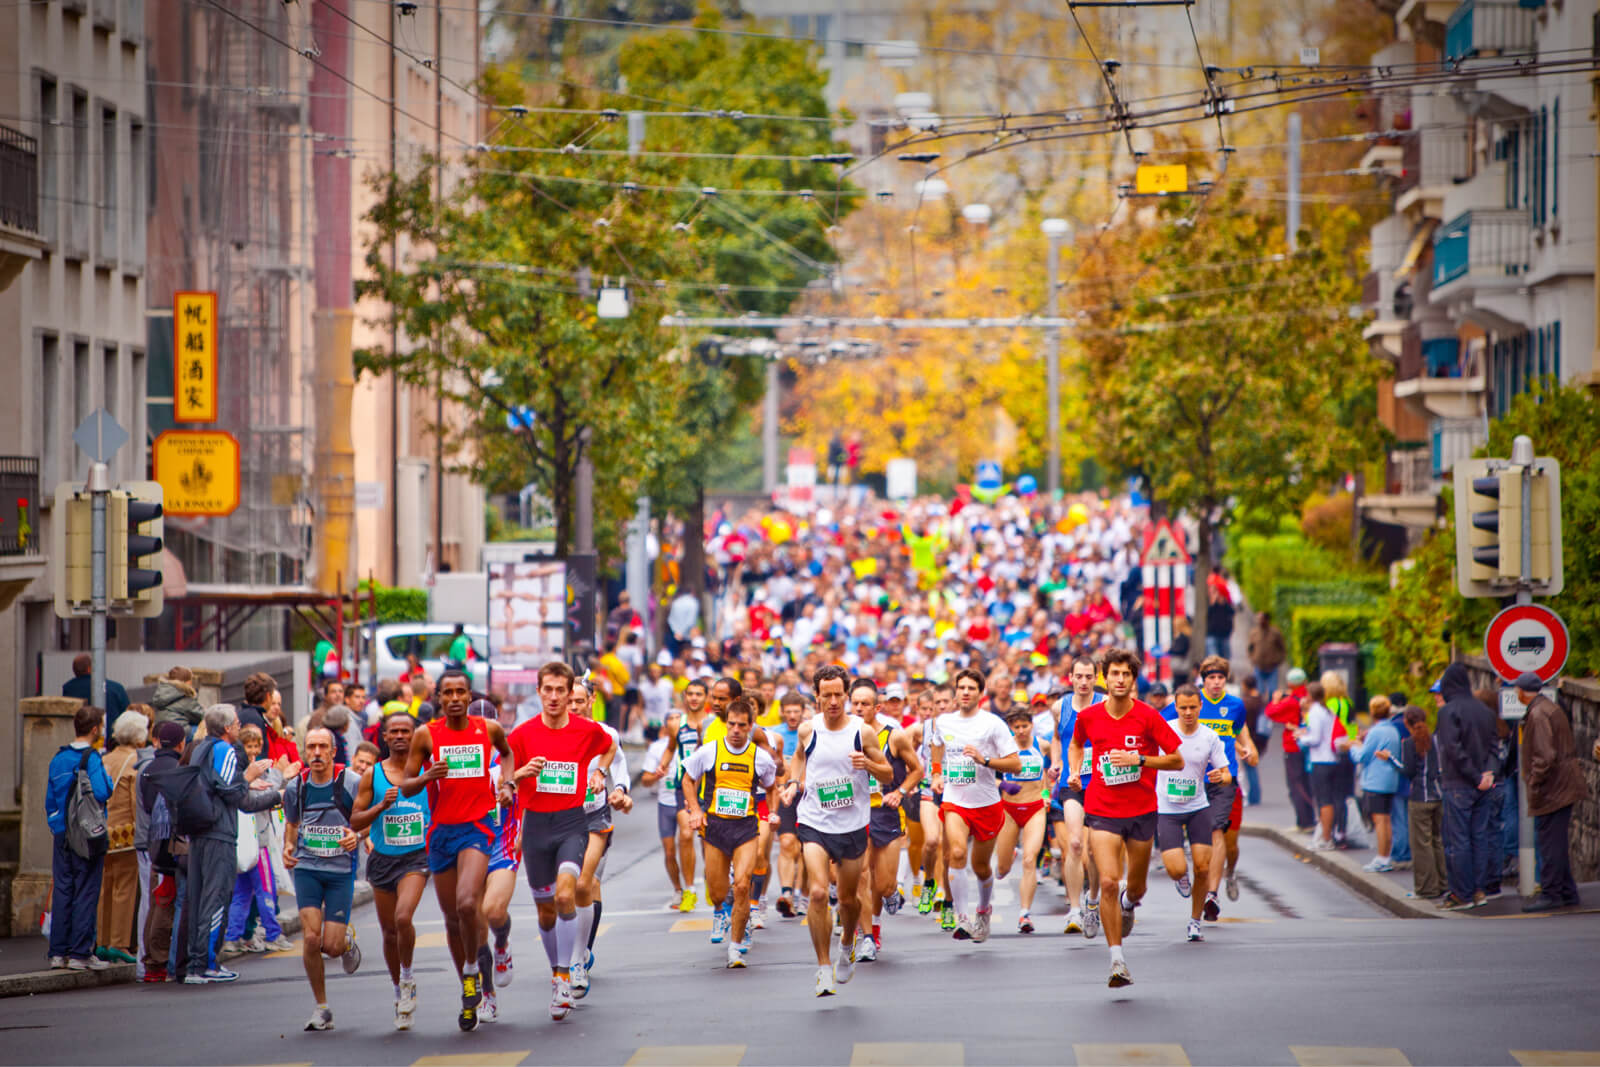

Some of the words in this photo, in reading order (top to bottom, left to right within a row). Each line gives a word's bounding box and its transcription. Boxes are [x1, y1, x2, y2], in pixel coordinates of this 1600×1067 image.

[442, 745, 481, 755] MIGROS
[815, 780, 836, 788] Swiss
[835, 776, 851, 785] Life
[1167, 776, 1198, 785] MIGROS
[537, 784, 559, 792] Swiss
[559, 785, 575, 793] Life
[735, 790, 749, 798] Life
[820, 797, 855, 809] MIGROS
[717, 807, 746, 816] MIGROS
[384, 814, 422, 824] MIGROS
[307, 826, 342, 835] MIGROS
[396, 824, 412, 837] 25
